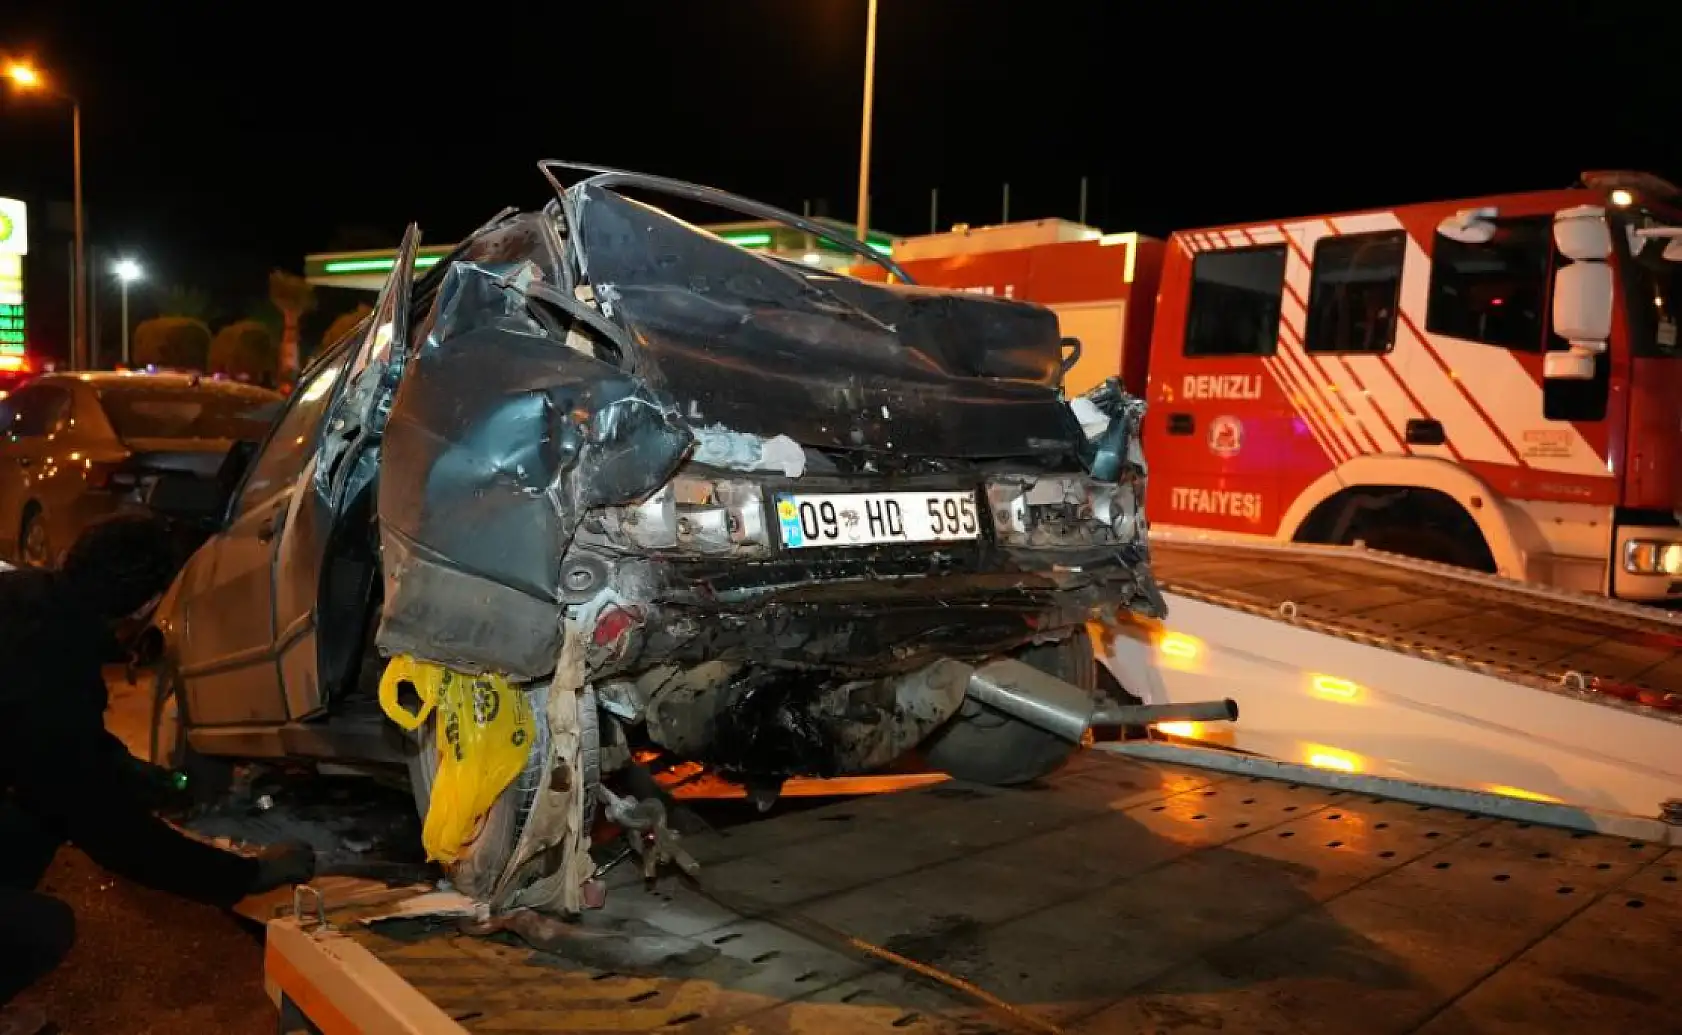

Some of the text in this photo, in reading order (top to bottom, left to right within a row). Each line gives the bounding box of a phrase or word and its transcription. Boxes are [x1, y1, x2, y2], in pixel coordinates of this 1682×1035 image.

[800, 500, 838, 540] 09
[866, 498, 904, 537] HD
[926, 497, 976, 535] 595
